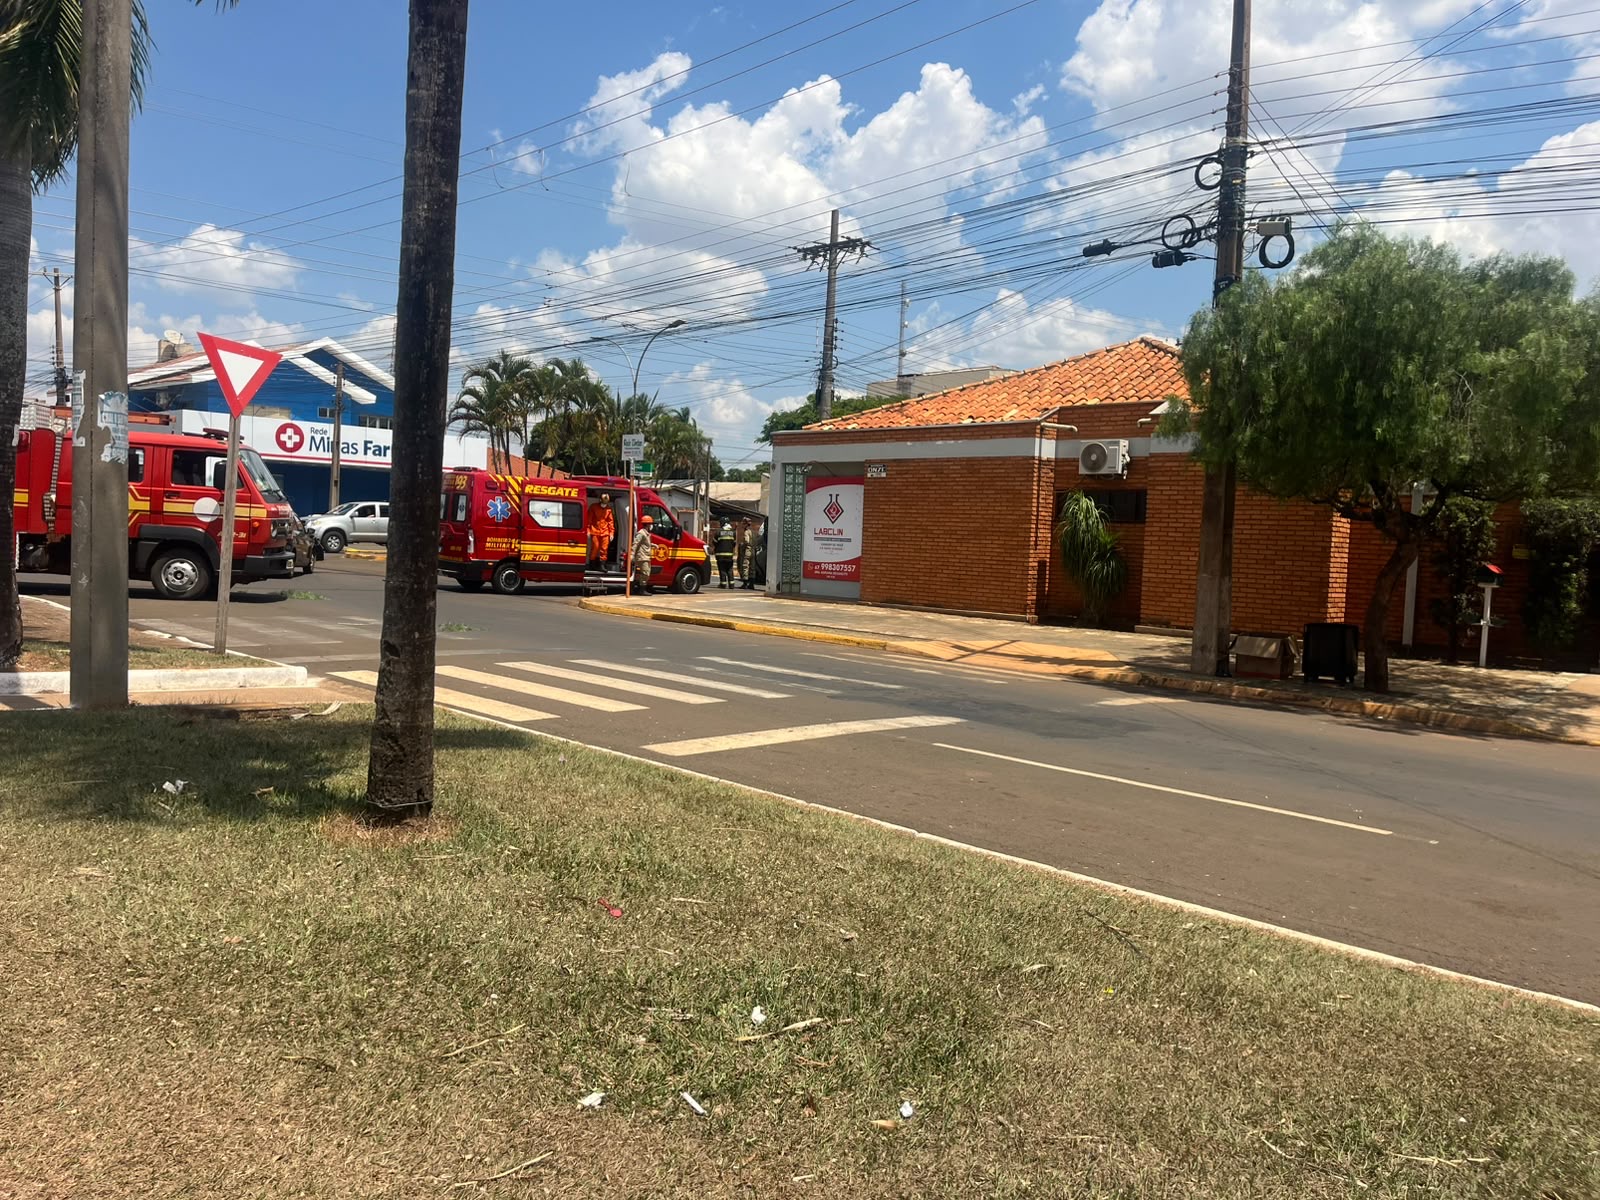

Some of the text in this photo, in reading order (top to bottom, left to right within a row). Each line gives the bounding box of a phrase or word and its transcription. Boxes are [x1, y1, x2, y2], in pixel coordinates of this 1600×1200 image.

[310, 426, 328, 436] Rede
[309, 435, 391, 458] Mias Far
[525, 484, 579, 497] RESGATE
[813, 527, 844, 536] LABCLIN
[820, 563, 856, 572] 998307557
